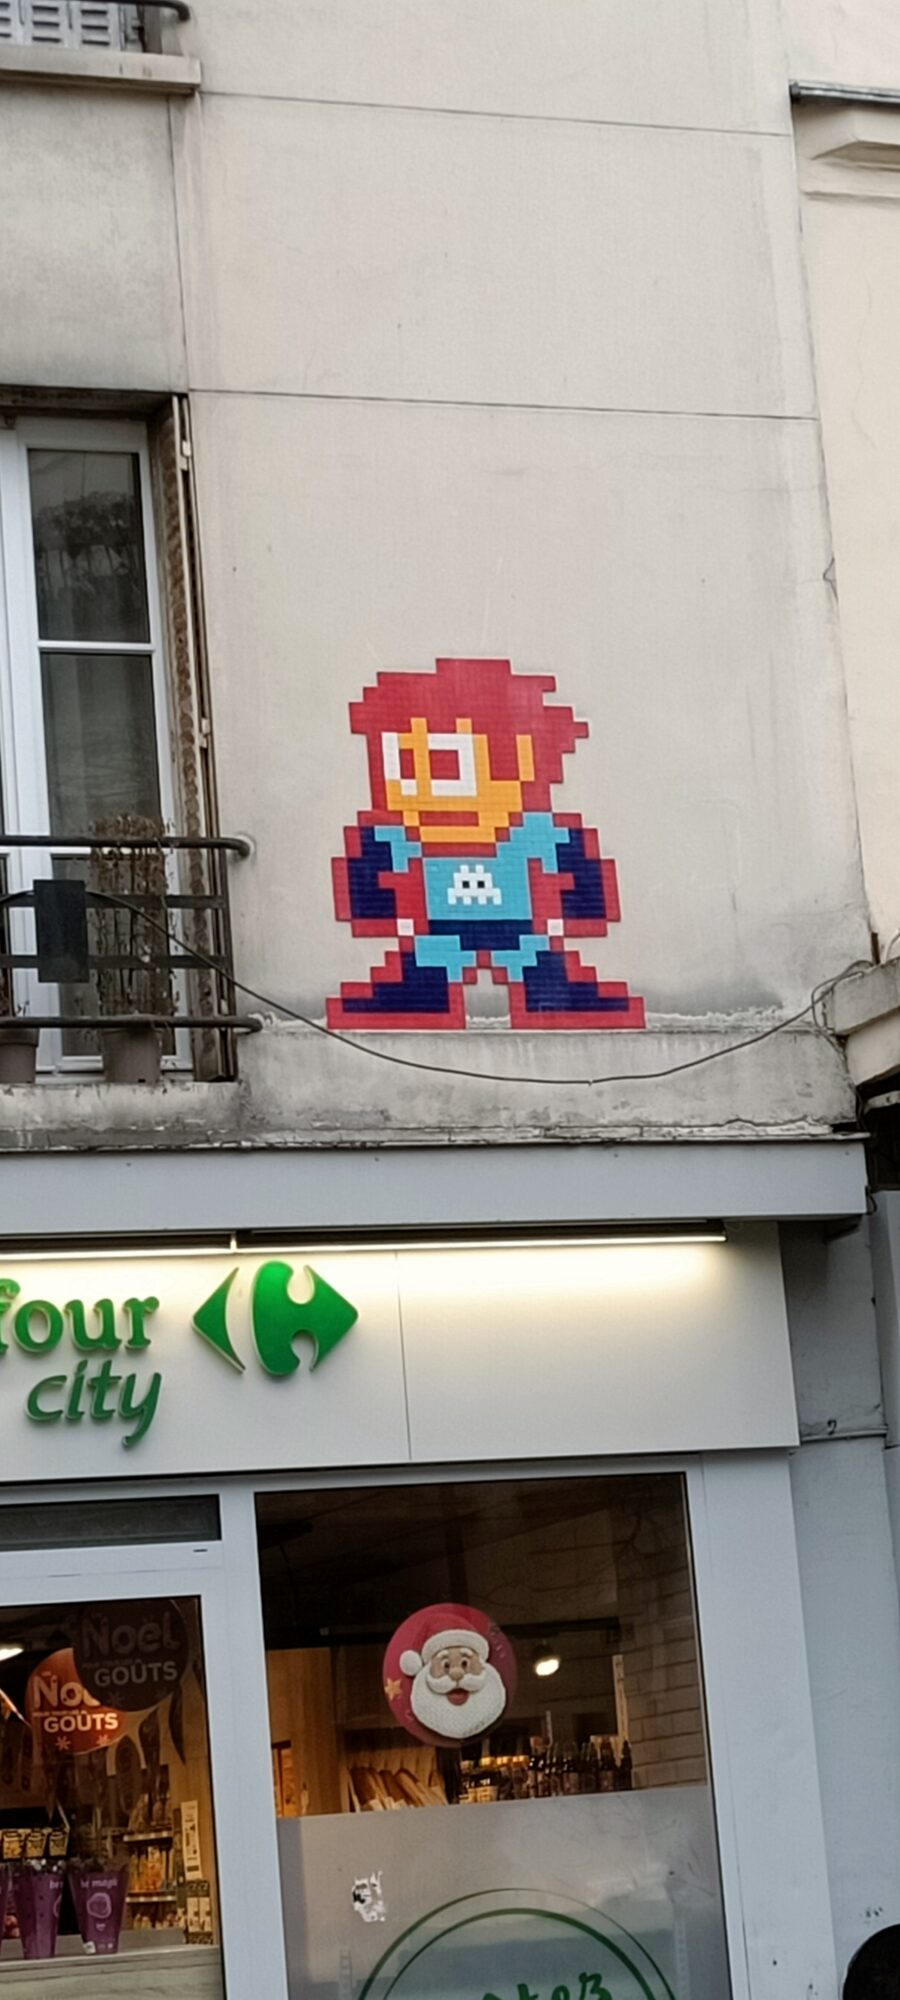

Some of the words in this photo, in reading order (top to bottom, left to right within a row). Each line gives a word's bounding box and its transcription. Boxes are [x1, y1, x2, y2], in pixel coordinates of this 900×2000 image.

[25, 1359, 162, 1447] city
[94, 1659, 178, 1687] GOÛTS
[44, 1711, 119, 1733] GOÛTS
